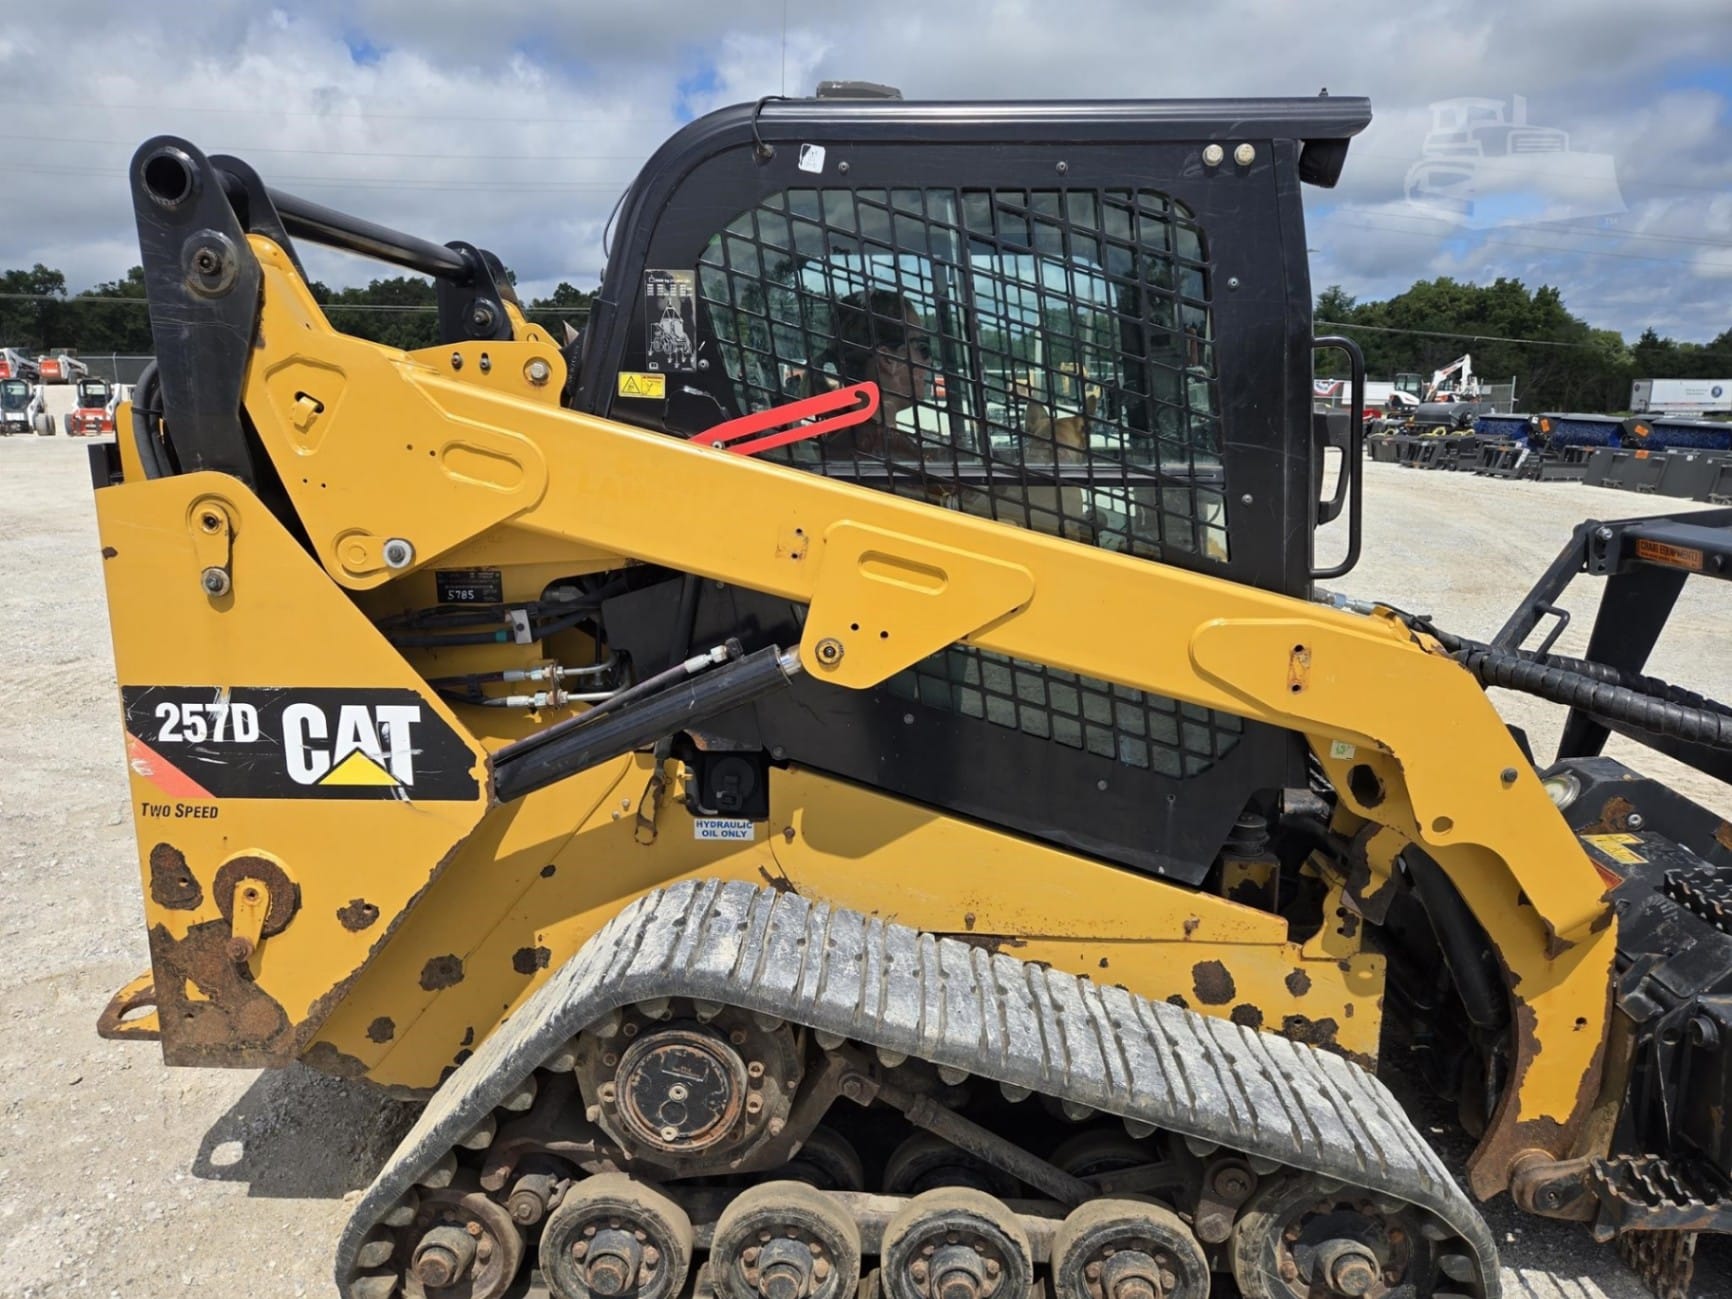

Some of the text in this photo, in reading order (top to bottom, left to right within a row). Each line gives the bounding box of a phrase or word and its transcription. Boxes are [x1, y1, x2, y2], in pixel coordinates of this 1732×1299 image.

[155, 702, 421, 785] 257D CAT
[696, 820, 753, 829] HYDRAULIC
[702, 829, 747, 838] OIL ONLY
